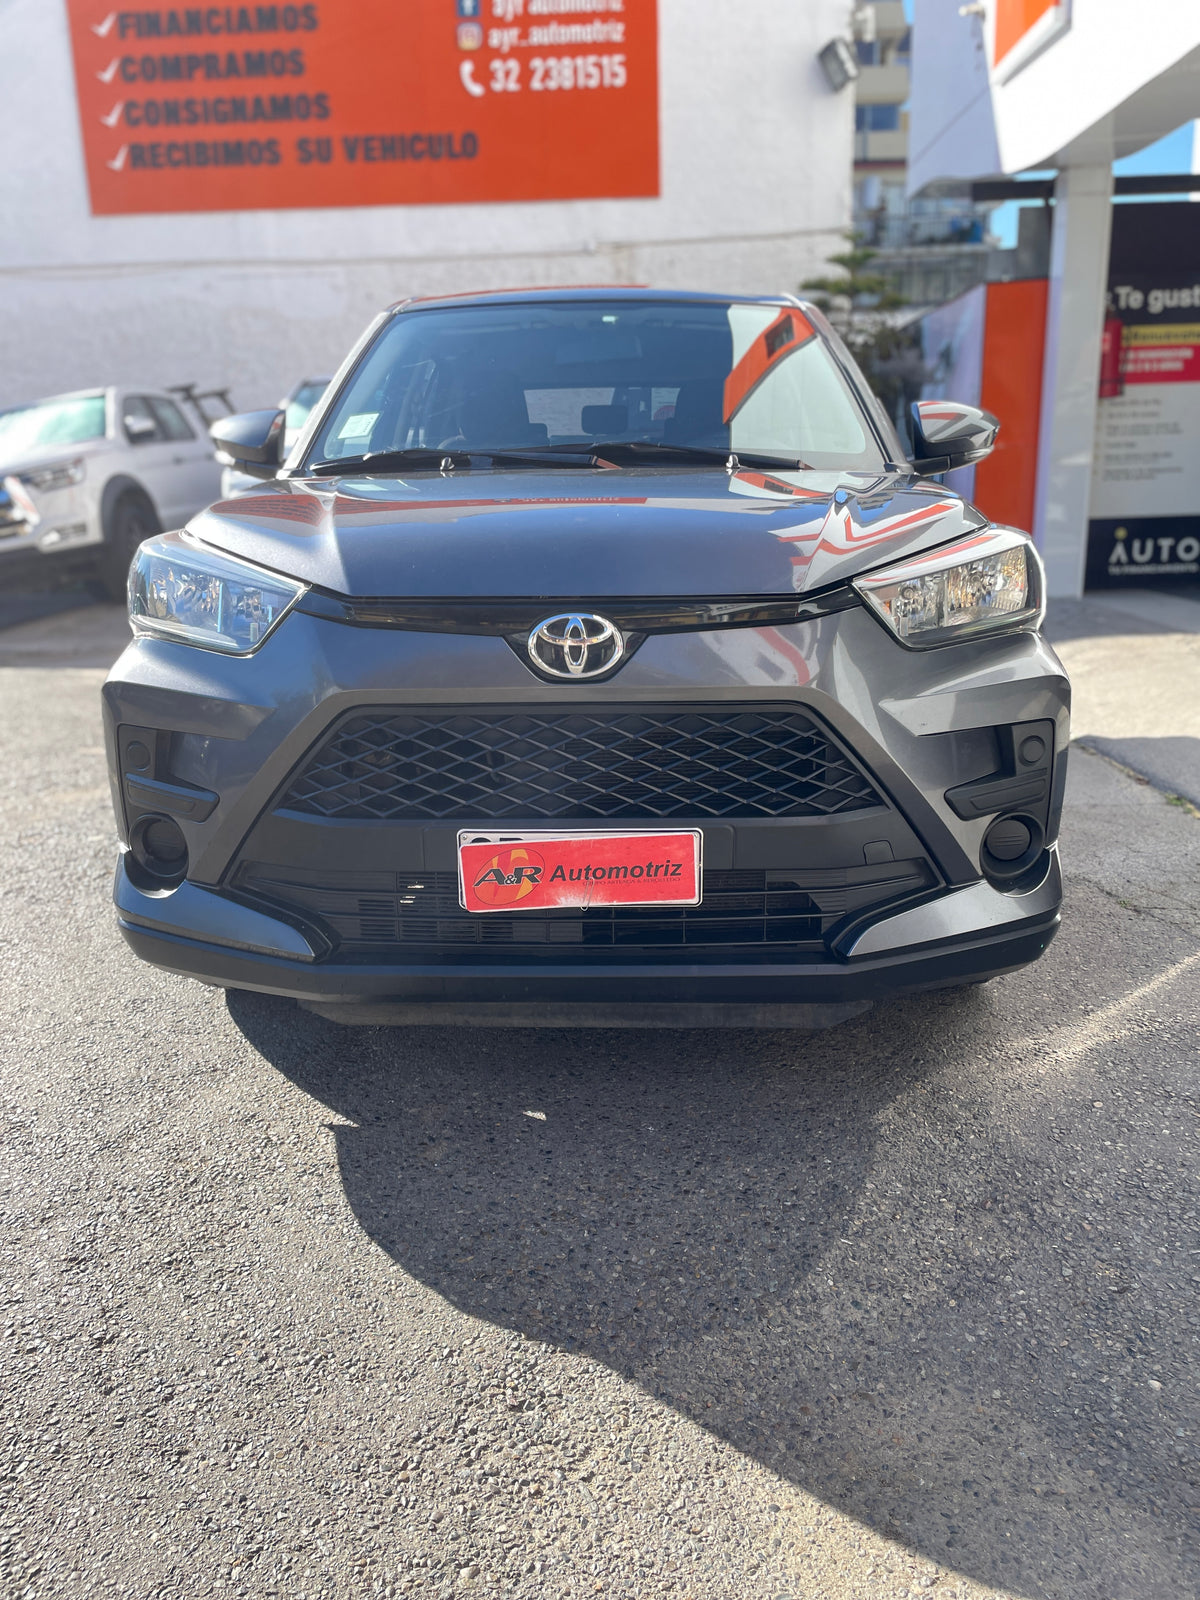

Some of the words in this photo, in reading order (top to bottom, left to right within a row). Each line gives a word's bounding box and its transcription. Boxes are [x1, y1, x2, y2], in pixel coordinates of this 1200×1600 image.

[118, 5, 317, 38] FINANCIAMOS
[121, 50, 304, 81] COMPRAMOS
[490, 59, 520, 91] 32
[529, 54, 627, 91] 2381515
[126, 94, 329, 125] CONSIGNAMOS
[130, 139, 280, 169] RECIBIMOS
[296, 136, 332, 164] SU
[342, 131, 479, 163] VEHICULO
[473, 867, 542, 887] A&R
[549, 860, 682, 882] Automotriz
